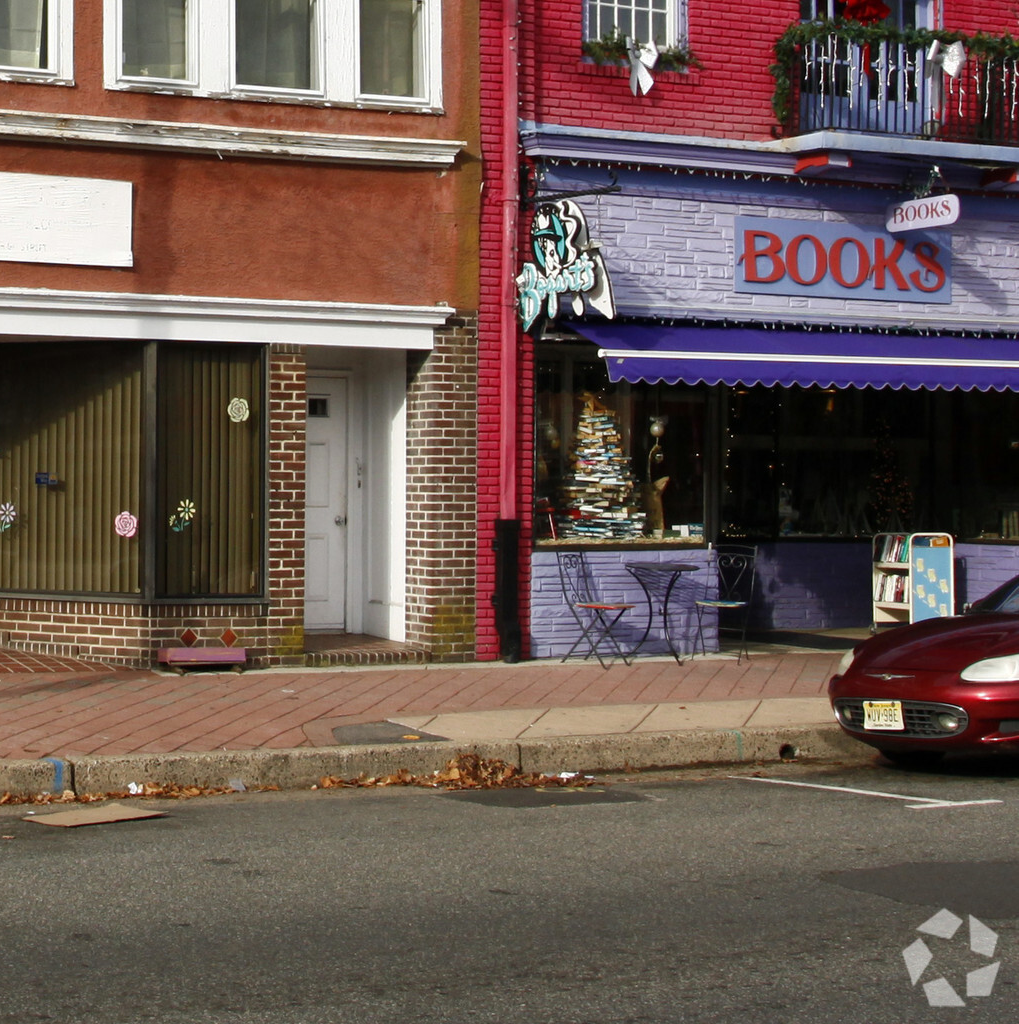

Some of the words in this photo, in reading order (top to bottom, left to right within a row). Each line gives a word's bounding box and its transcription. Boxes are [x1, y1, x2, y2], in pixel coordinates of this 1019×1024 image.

[892, 199, 952, 225] BOOKS
[517, 251, 596, 333] Bogart's
[737, 229, 947, 293] BOOKS
